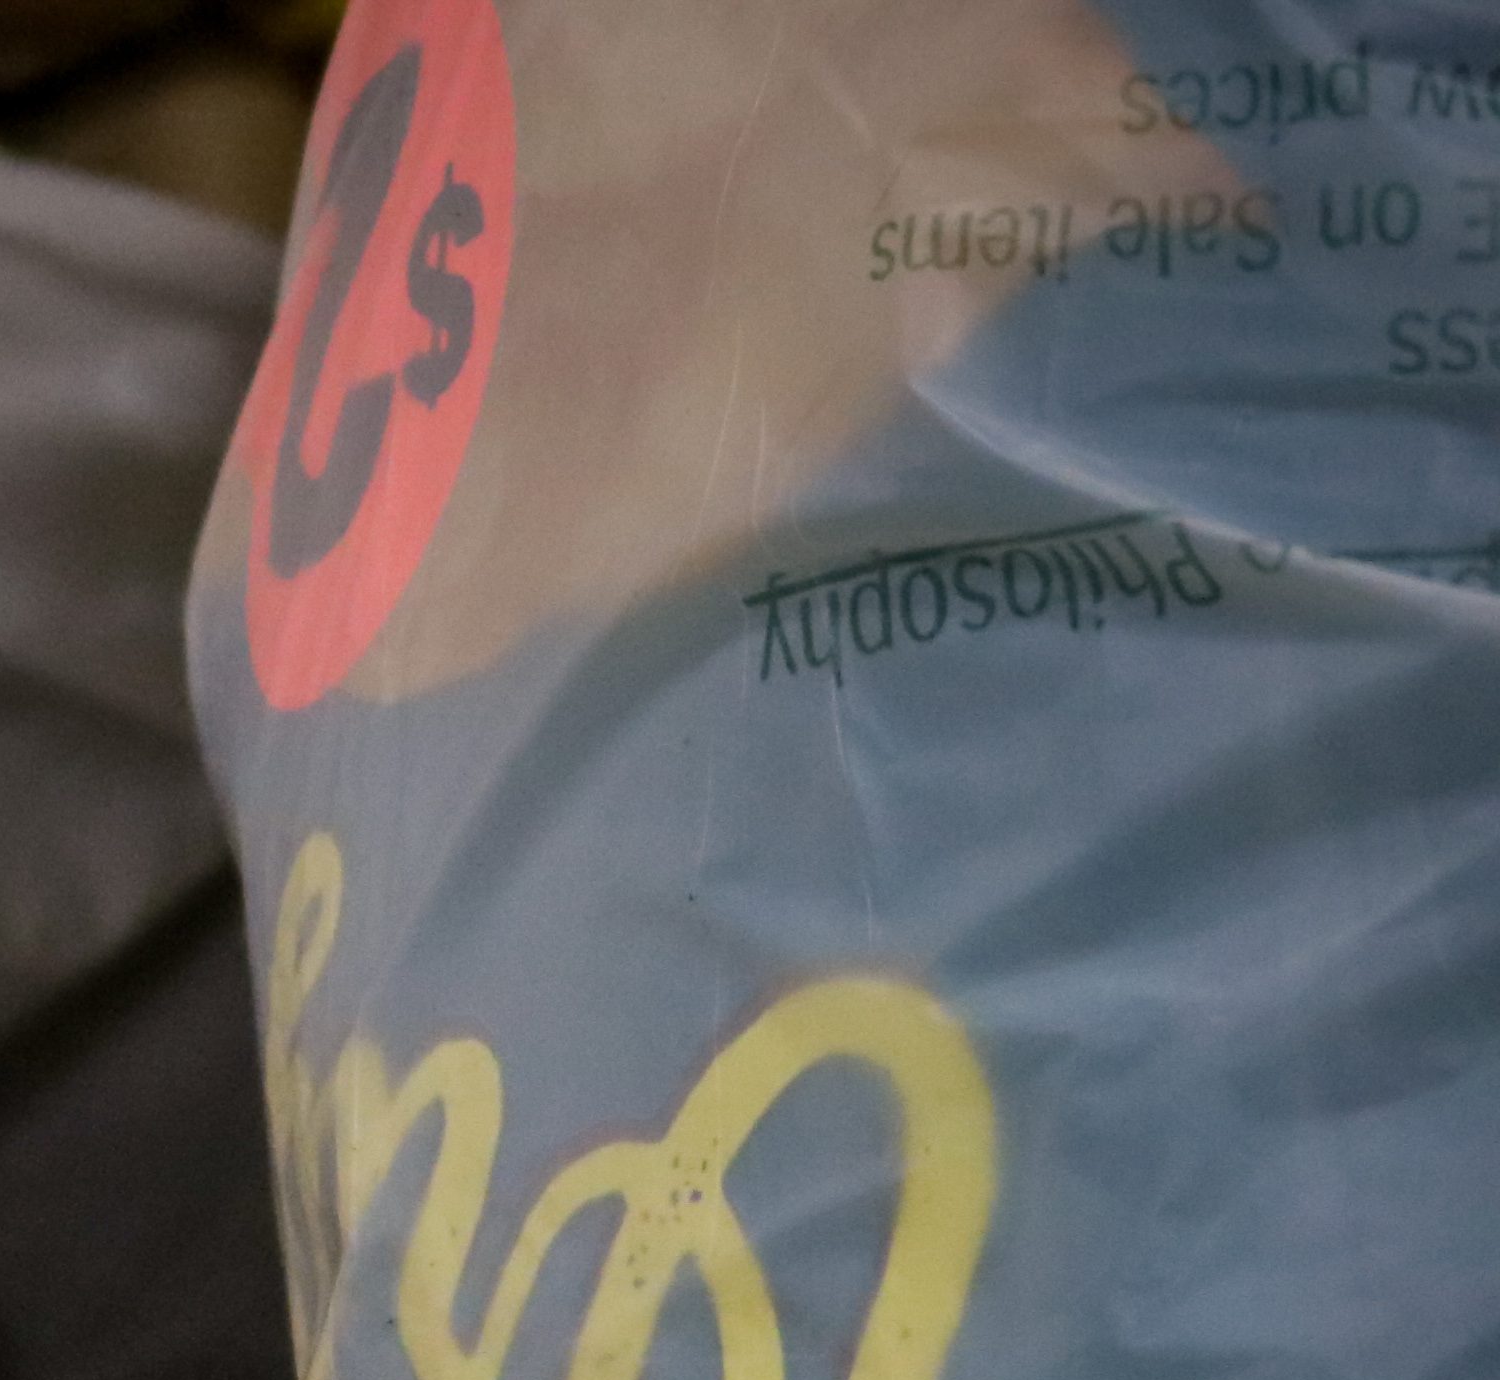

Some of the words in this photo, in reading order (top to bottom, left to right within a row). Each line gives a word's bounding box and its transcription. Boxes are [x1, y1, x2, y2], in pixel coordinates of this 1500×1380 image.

[1120, 38, 1372, 138] prices
[868, 205, 1073, 283] items
[1107, 190, 1282, 276] Sale
[1315, 180, 1422, 250] on
[750, 515, 1222, 688] Philosophy
